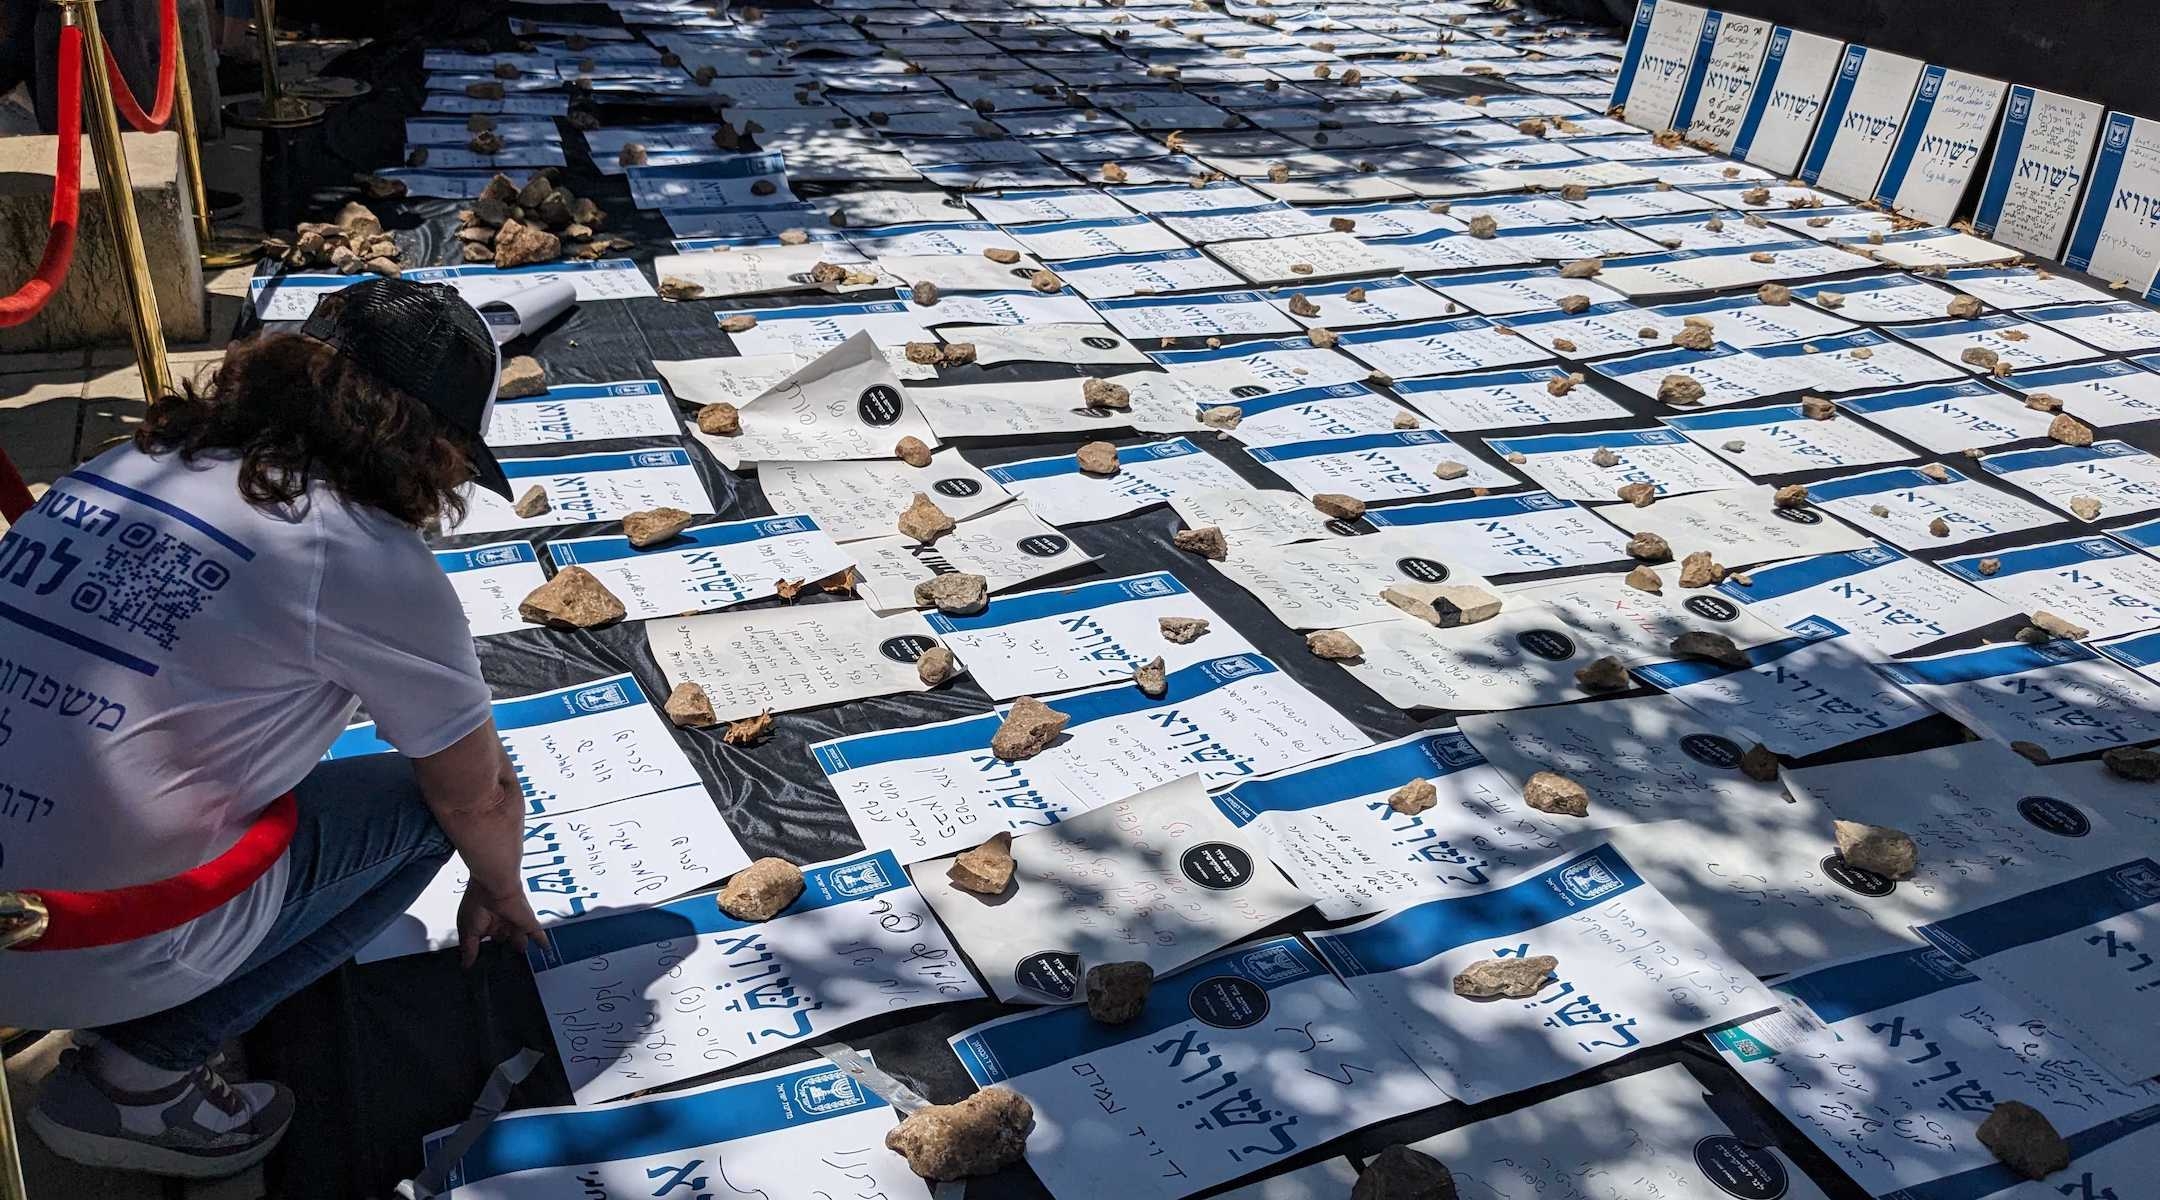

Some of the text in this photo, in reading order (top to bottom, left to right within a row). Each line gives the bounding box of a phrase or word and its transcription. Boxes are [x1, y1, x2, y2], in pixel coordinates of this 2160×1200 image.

[1641, 54, 1686, 83] לשווא
[1706, 70, 1752, 100] לשווא
[1771, 89, 1819, 122] לשווא
[1844, 110, 1898, 144] לשווא
[1920, 134, 1979, 169] לשווא
[2018, 158, 2080, 197] לשווא
[983, 296, 1030, 325] לשווא
[1176, 306, 1228, 333] לשווא
[1726, 309, 1801, 339] לשווא
[1417, 336, 1485, 368] לשווא
[1968, 334, 2049, 365] לשווא
[1241, 355, 1307, 391] לשווא
[535, 404, 583, 443] לשווא
[1486, 387, 1553, 424] לשווא
[1932, 401, 2022, 441] לשווא
[1760, 424, 1845, 467] לשווא
[1354, 450, 1432, 495] לשווא
[551, 476, 608, 522] לשווא
[1895, 491, 1997, 536] לשווא
[1474, 519, 1566, 570] לשווא
[681, 551, 755, 608] לשווא
[1829, 582, 1947, 640] לשווא
[1761, 665, 1888, 732] לשווא
[2002, 678, 2130, 744] לשווא
[613, 730, 635, 742] של
[1146, 710, 1256, 792] לשווא
[971, 755, 1073, 830] לשווא
[671, 837, 689, 847] של
[521, 821, 599, 921] לשווא
[631, 860, 668, 896] שלמה
[837, 941, 883, 966] שלי
[715, 933, 824, 1047] לשווא
[1868, 1017, 1996, 1115] שווא
[1152, 1027, 1299, 1163] לשווא
